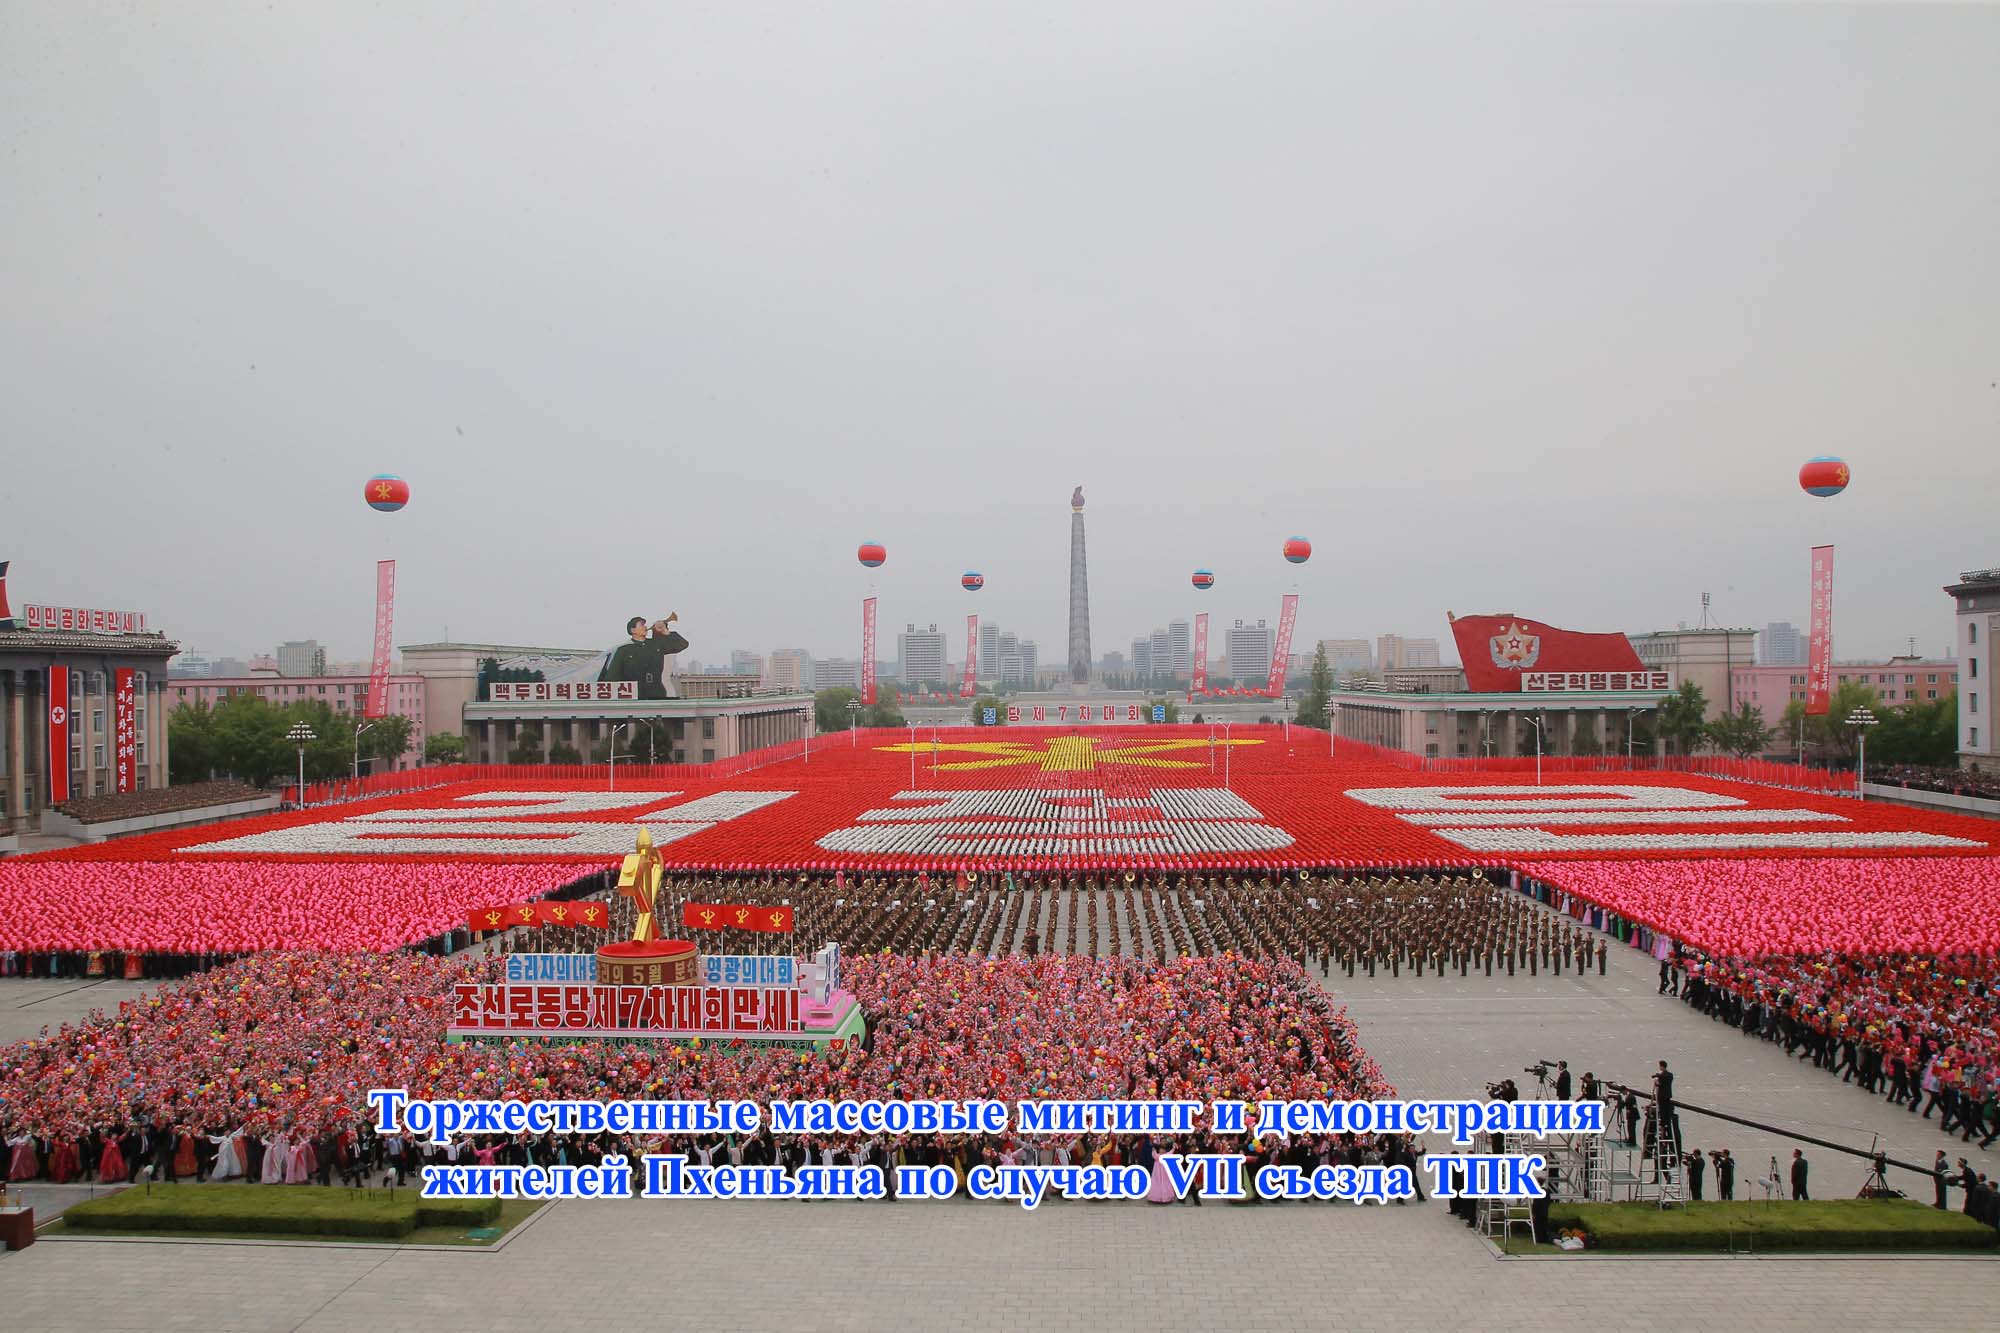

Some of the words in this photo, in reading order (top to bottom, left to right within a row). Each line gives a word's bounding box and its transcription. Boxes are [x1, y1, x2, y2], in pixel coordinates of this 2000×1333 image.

[28, 606, 146, 633] 인민공화국만세!
[494, 682, 633, 701] 백두의혁명정신
[1527, 672, 1669, 691] 선군혁명총진군
[125, 676, 135, 756] 조선로동당
[707, 956, 793, 984] 영광의대회
[454, 984, 802, 1032] 조선로동당제7차대회만세!
